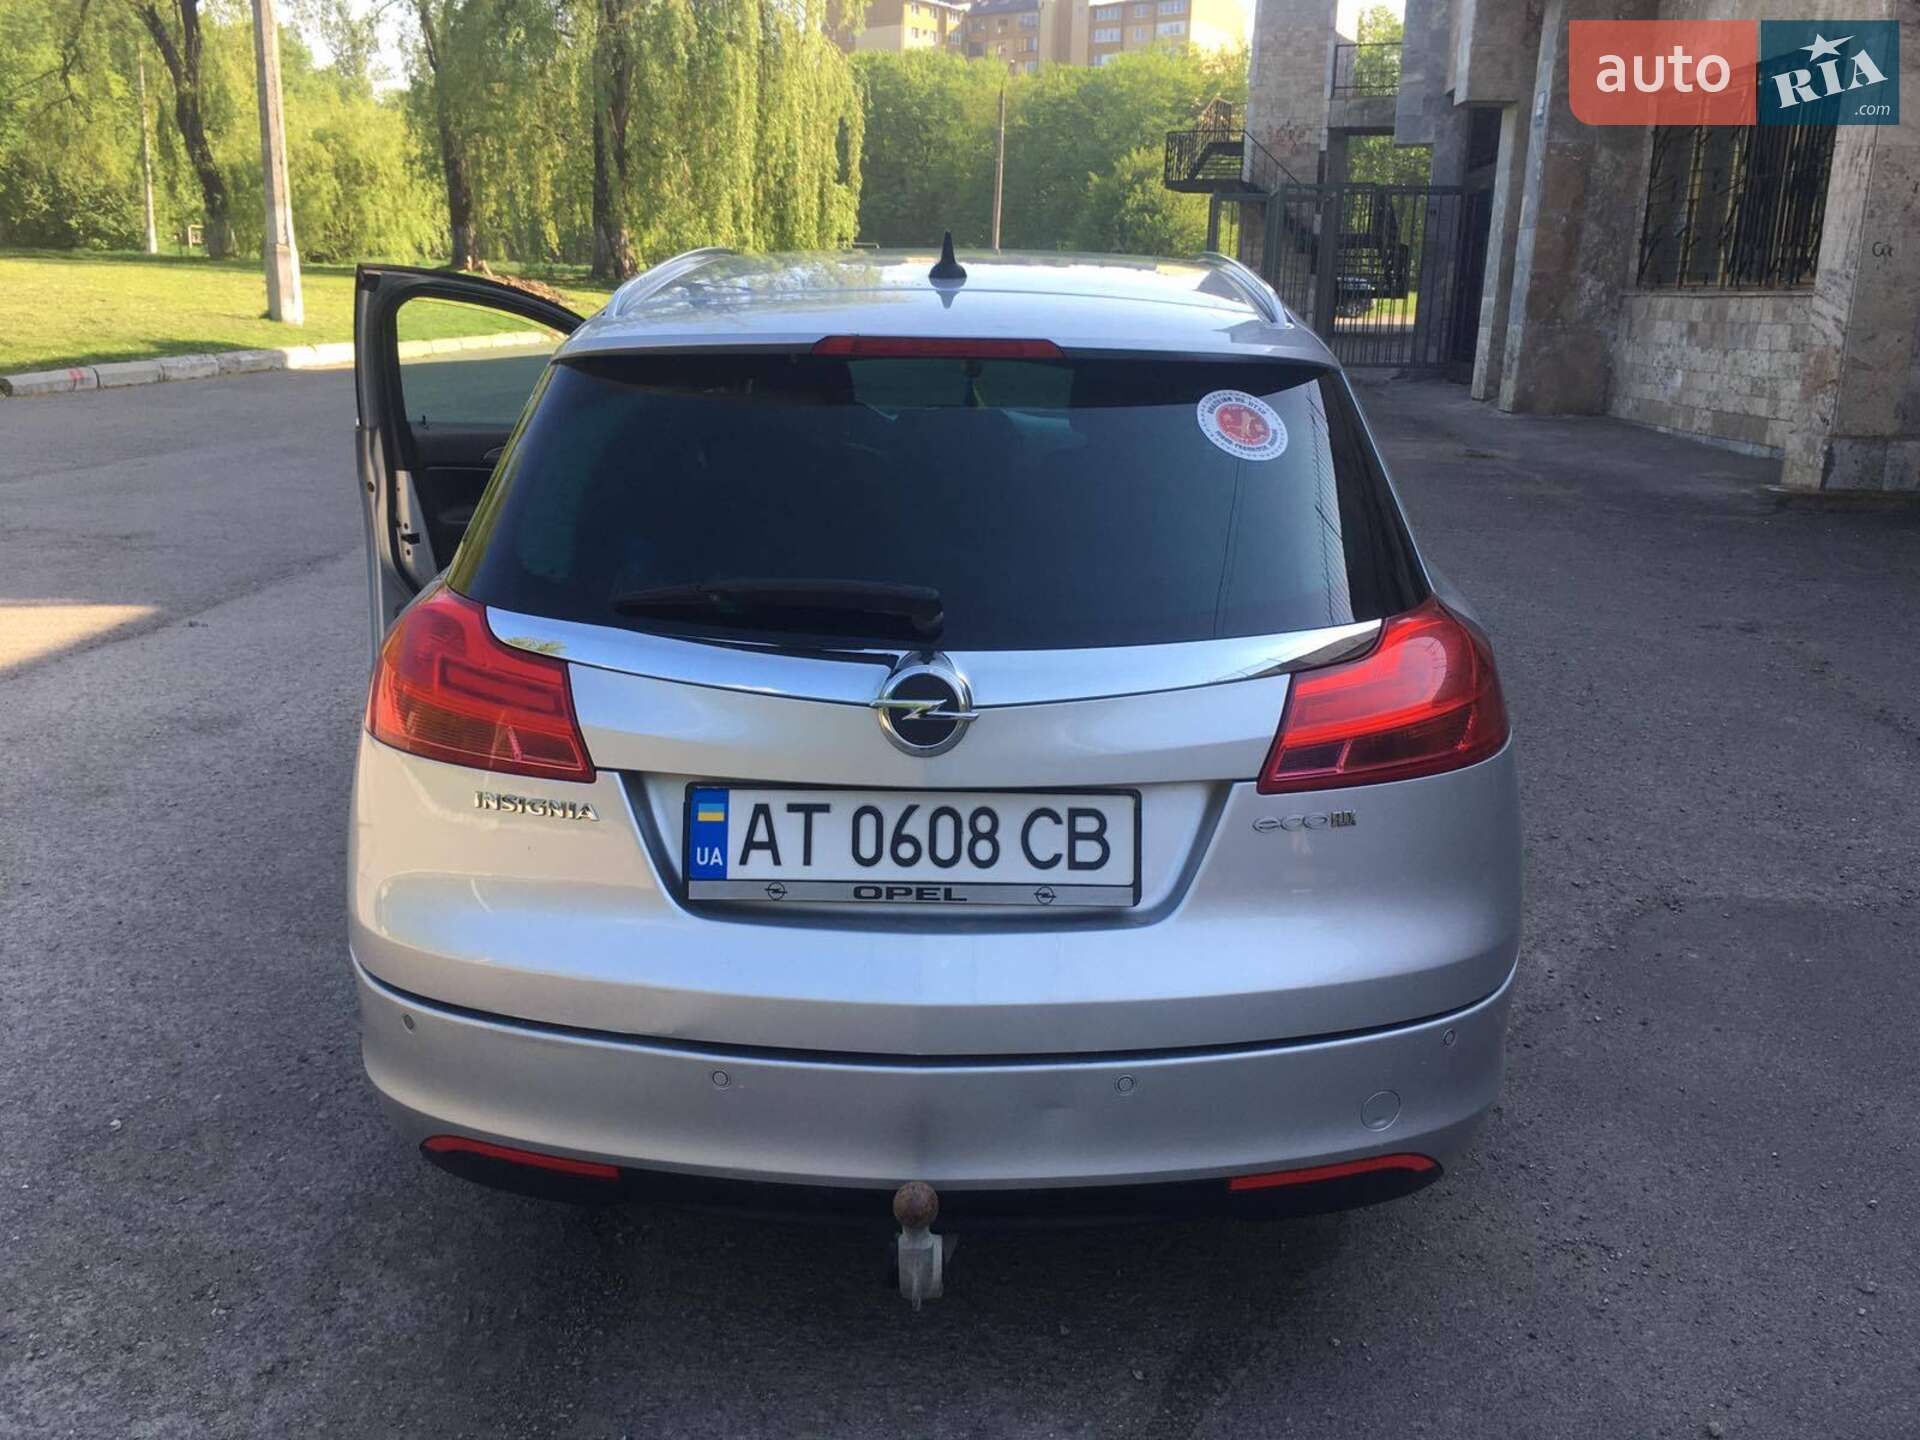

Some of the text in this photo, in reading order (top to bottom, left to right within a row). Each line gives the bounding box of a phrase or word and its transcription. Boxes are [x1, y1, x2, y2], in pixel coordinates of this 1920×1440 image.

[474, 790, 600, 822] INSIGNIA
[738, 803, 1112, 870] AT 0608 CB
[695, 847, 725, 867] UA
[853, 886, 968, 902] OPEL
